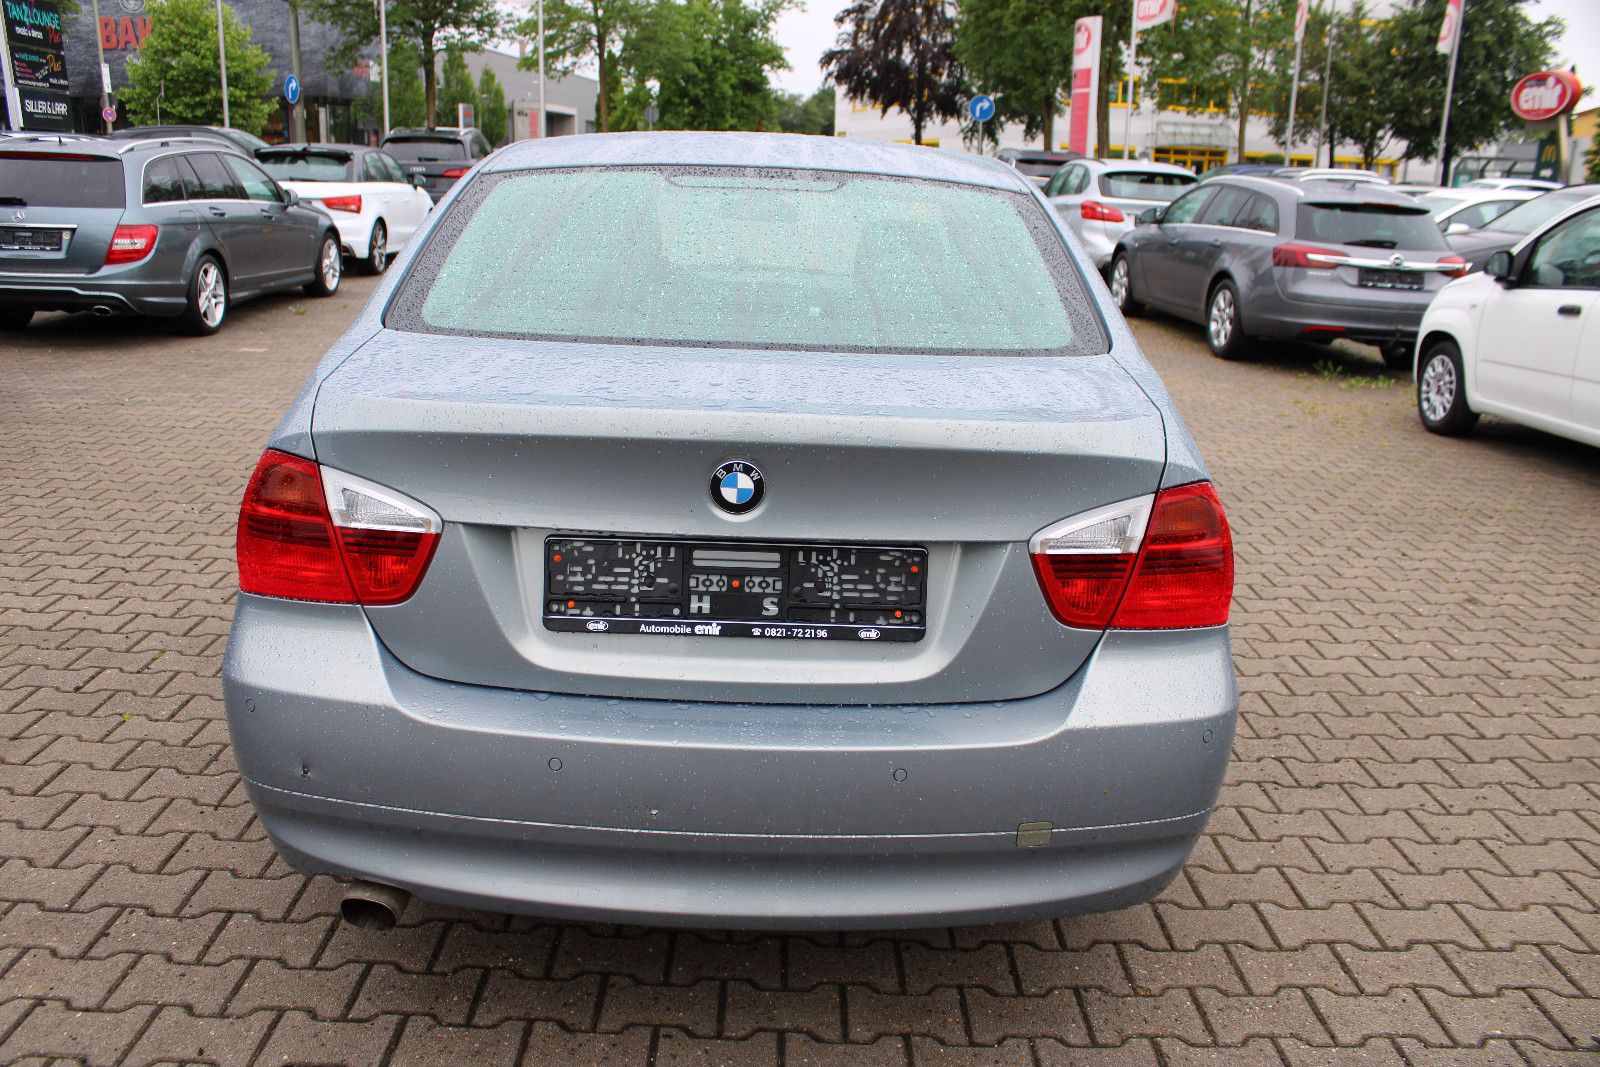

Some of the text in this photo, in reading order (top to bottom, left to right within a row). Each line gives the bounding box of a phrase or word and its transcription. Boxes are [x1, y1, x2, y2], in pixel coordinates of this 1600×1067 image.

[1518, 76, 1562, 110] emir
[25, 100, 47, 113] SILLER
[52, 103, 68, 115] LAAR
[716, 463, 761, 480] BMW
[639, 622, 721, 635] Automobile emir
